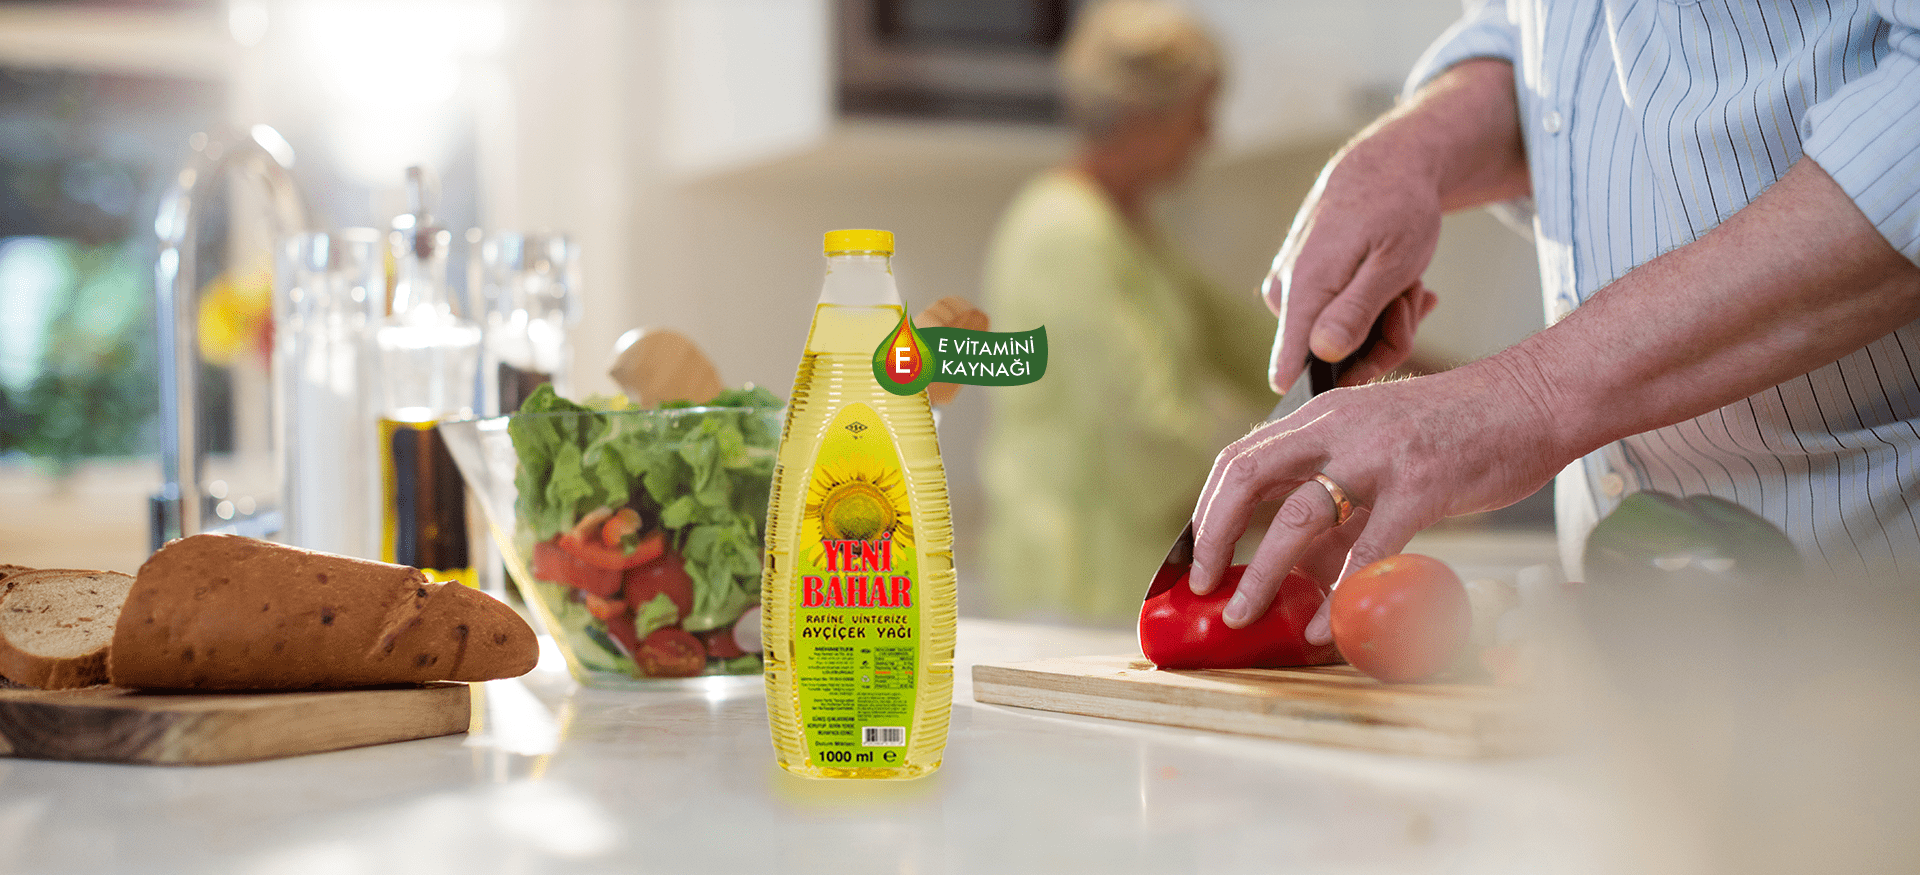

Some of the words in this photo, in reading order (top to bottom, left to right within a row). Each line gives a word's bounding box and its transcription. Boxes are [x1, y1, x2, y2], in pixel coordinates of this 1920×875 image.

[821, 531, 893, 573] YENİ
[801, 575, 913, 608] BAHAR
[802, 624, 866, 641] AYÇİÇEK
[877, 625, 912, 639] YAĞI
[819, 751, 852, 763] 1000
[856, 751, 874, 763] ml
